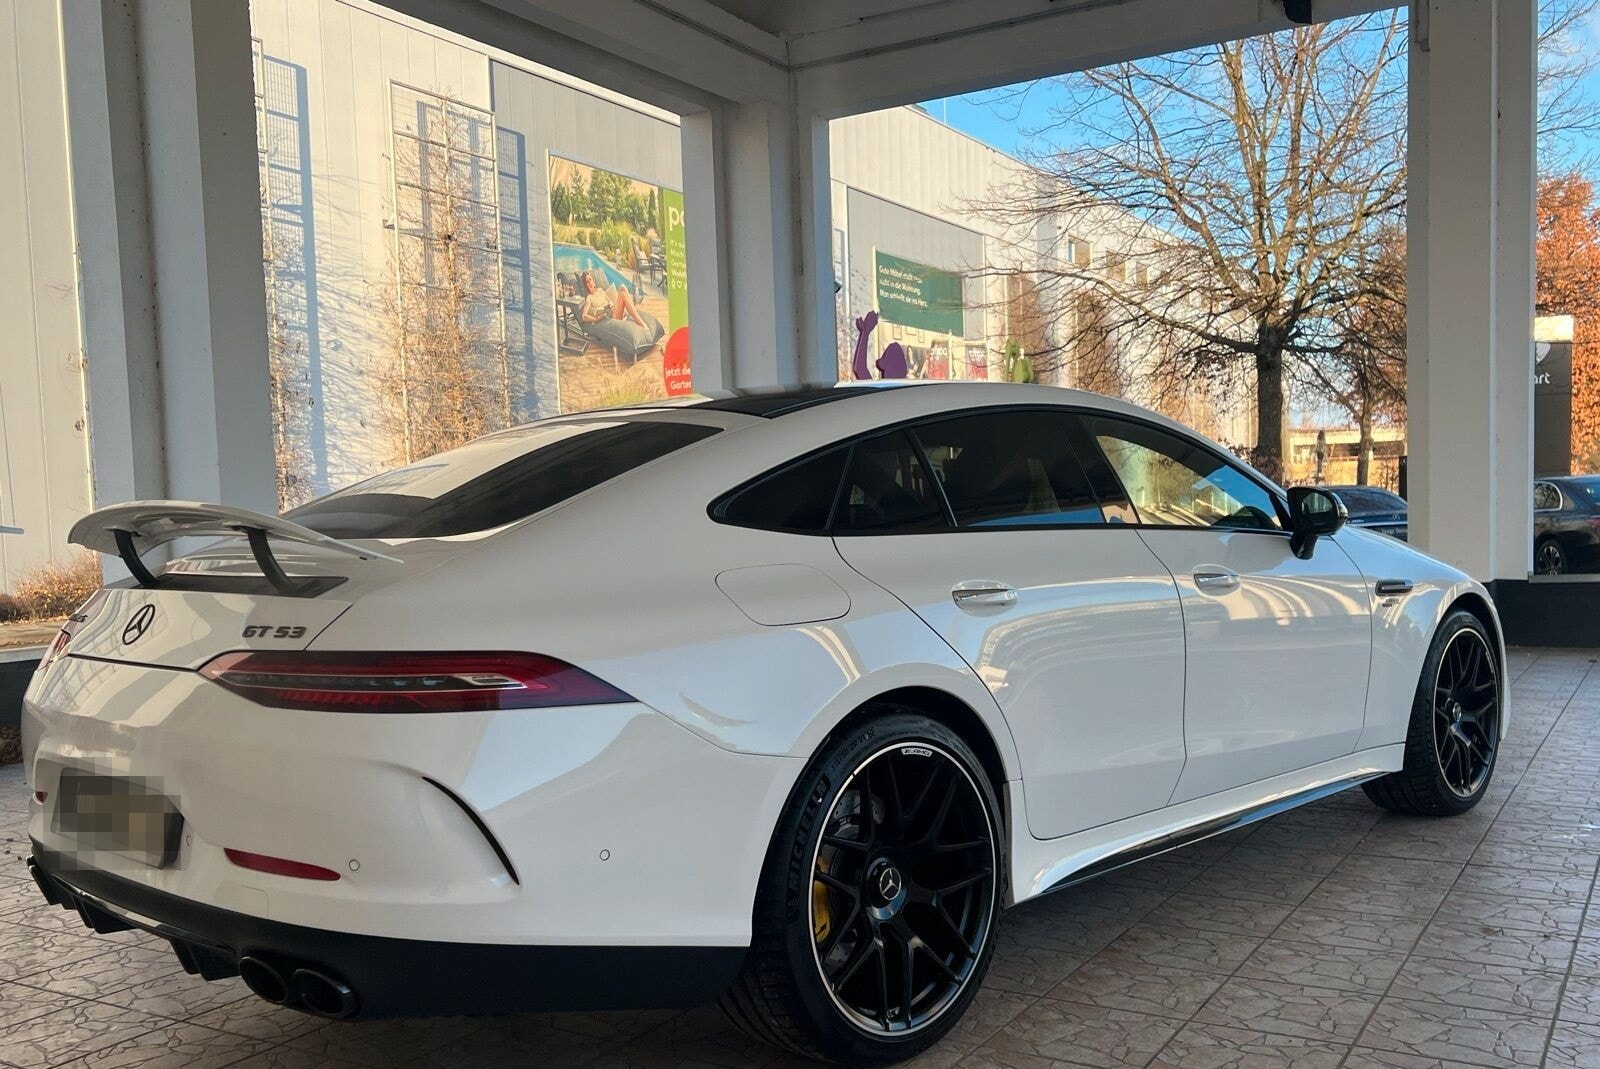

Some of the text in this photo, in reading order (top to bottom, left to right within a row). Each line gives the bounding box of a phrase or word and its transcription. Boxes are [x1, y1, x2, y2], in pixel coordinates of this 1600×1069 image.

[242, 625, 307, 639] GT 53
[912, 748, 931, 757] AMG
